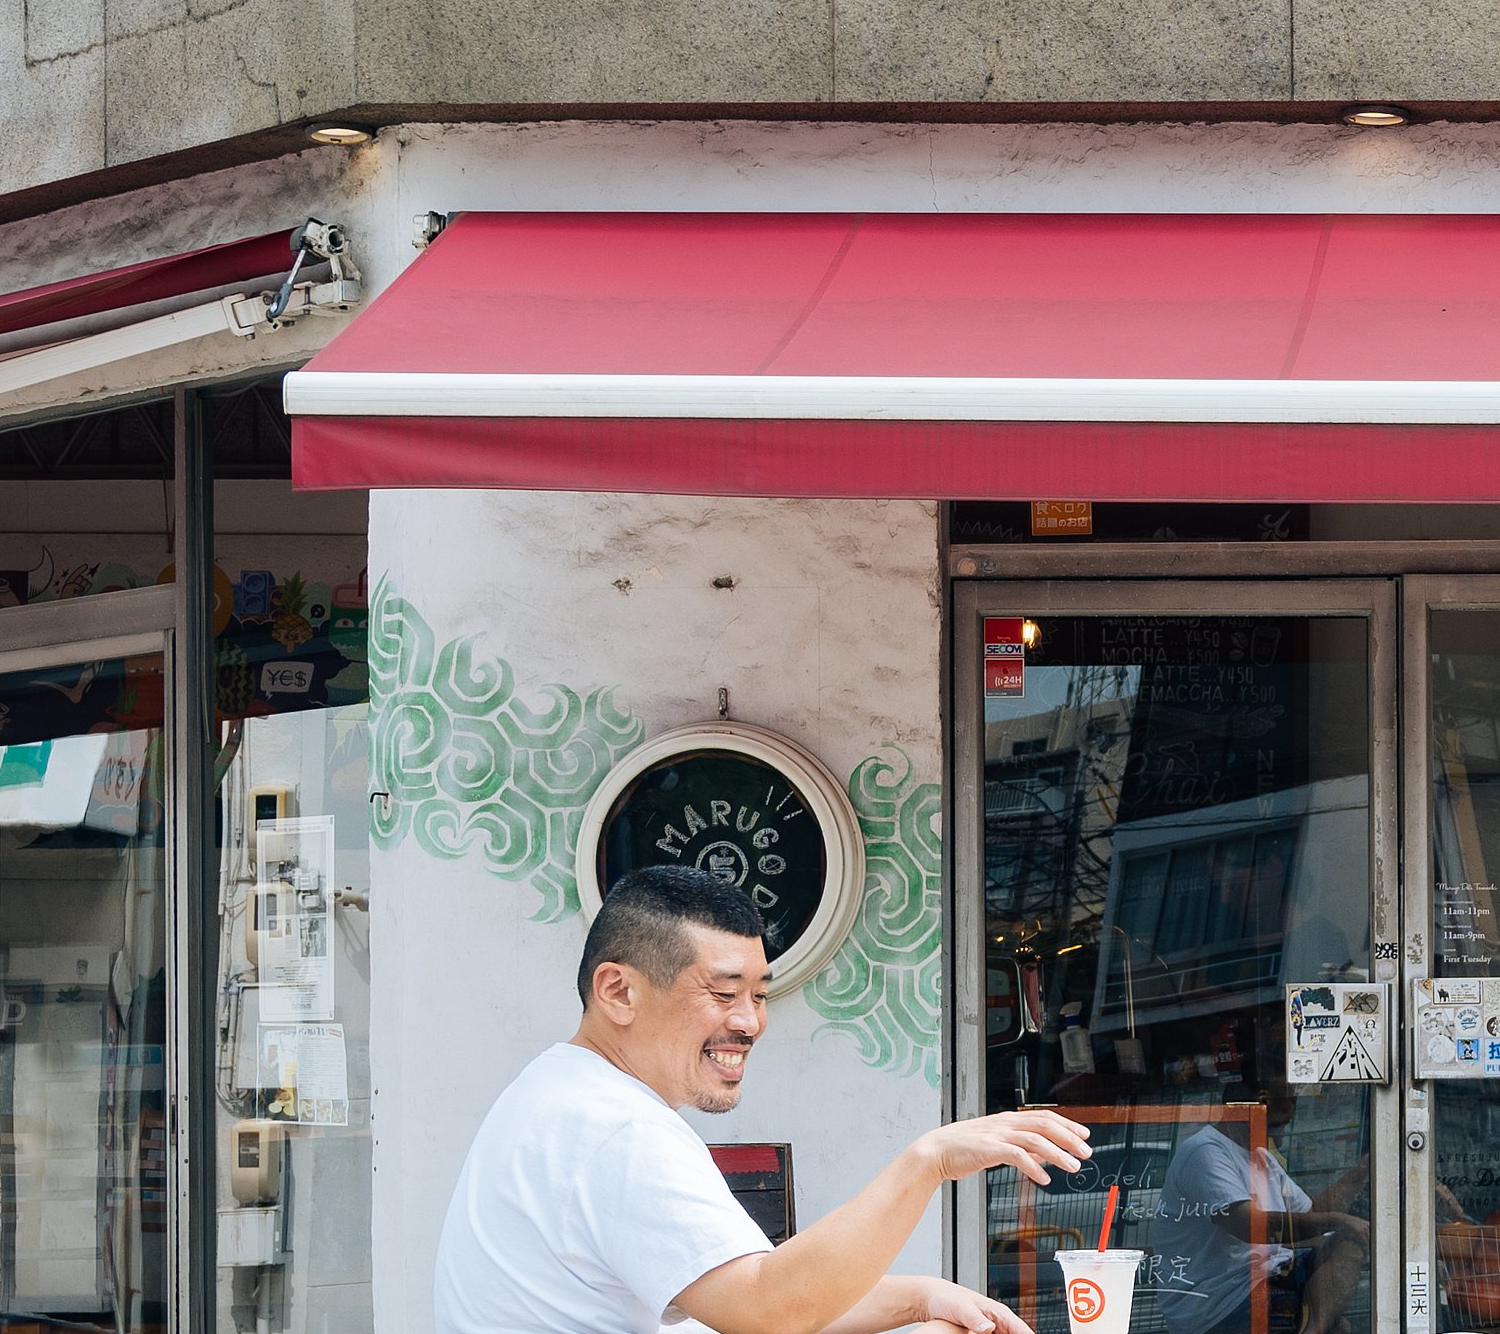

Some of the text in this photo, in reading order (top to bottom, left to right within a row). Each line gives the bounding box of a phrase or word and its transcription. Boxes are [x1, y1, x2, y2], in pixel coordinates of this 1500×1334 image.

[1036, 517, 1088, 528] 話題のお店
[1102, 628, 1164, 645] LATTE
[986, 644, 1022, 654] SECOM
[1102, 647, 1167, 664] MOCHA
[1004, 676, 1022, 685] 24H
[1141, 666, 1201, 683] LATTE
[1443, 907, 1490, 916] 11am-11pm
[1443, 931, 1486, 941] 11am-9pm
[1375, 950, 1398, 960] 246
[1443, 955, 1492, 964] First Tuesday
[1175, 1196, 1231, 1222] juice
[1136, 1254, 1195, 1285] 限定
[1410, 1265, 1428, 1316] 十三光
[1073, 1286, 1096, 1316] 5
